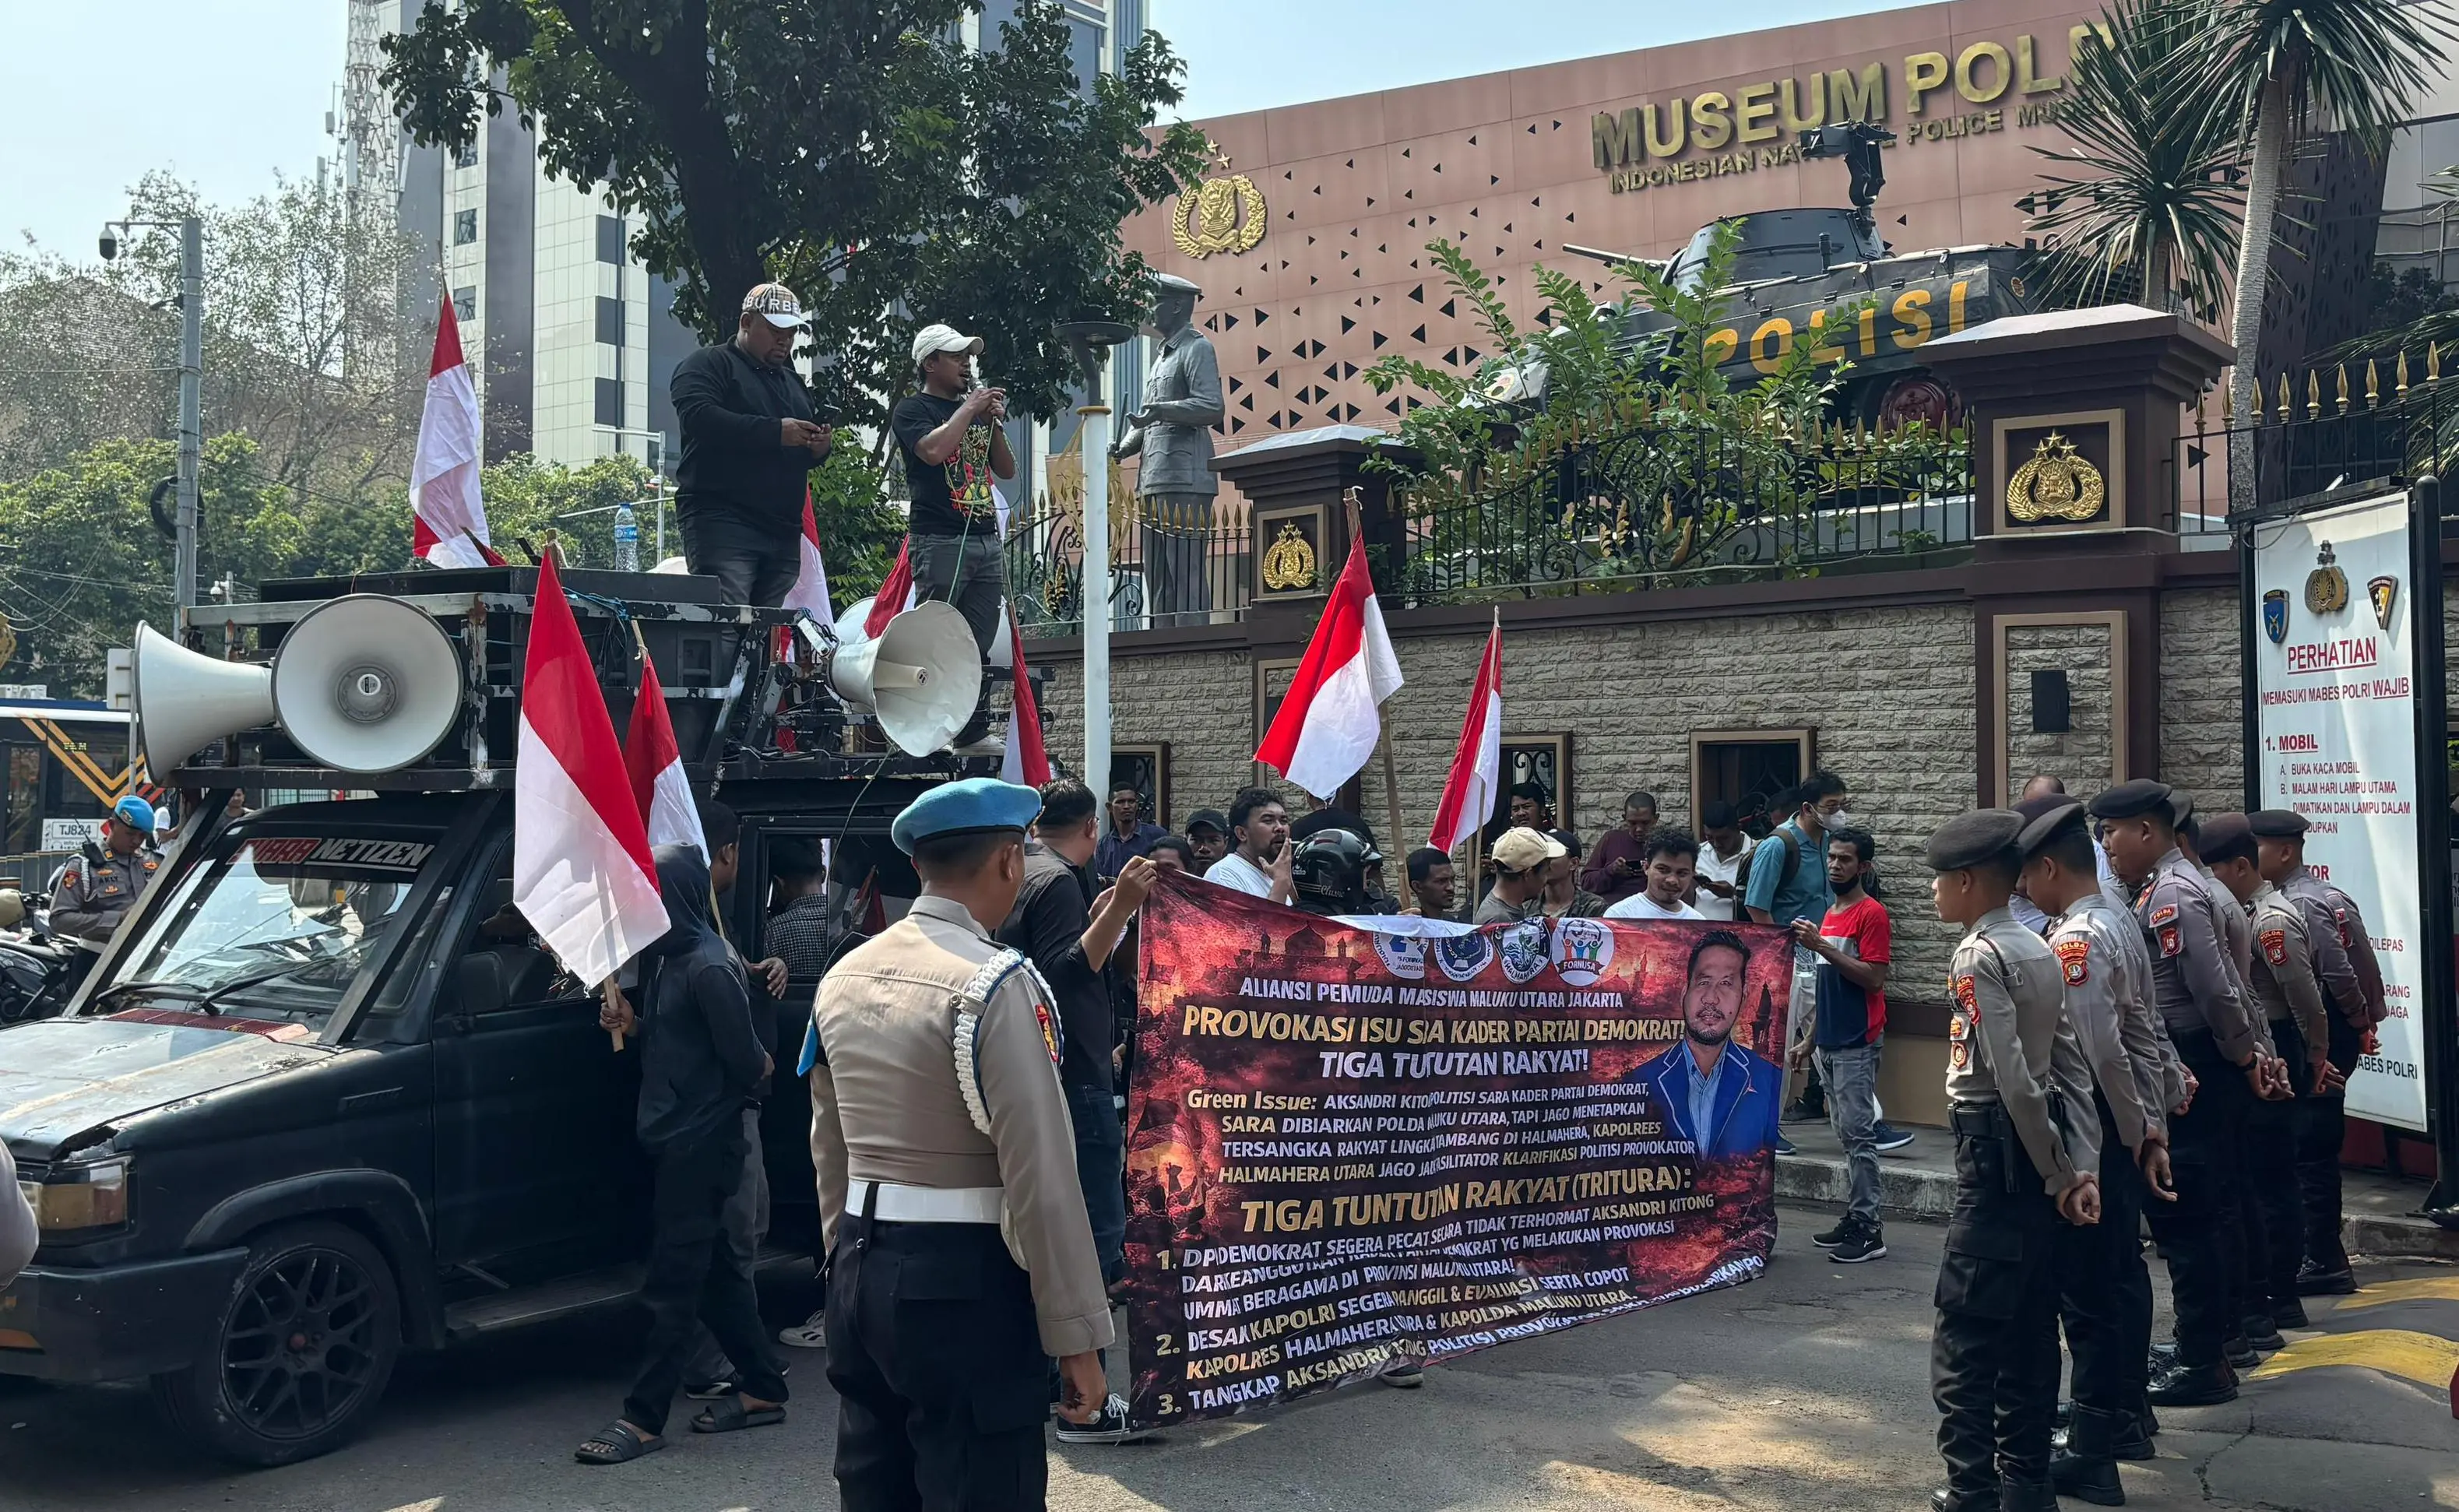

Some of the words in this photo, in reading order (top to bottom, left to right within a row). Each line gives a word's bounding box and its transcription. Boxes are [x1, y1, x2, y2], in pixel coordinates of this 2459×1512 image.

[1592, 62, 1887, 169] MUSEUM
[1609, 150, 1753, 194] INDONESIAN
[1907, 109, 2003, 144] POLICE
[1704, 280, 1968, 374] POLISI
[2288, 636, 2376, 674] PERHATIAN
[2263, 688, 2306, 705] MEMASUKI
[2309, 685, 2339, 701] MABES
[2343, 680, 2370, 698] POLRI
[2373, 677, 2409, 699] WAJIB
[2265, 737, 2275, 751] 1.
[2279, 734, 2318, 754] MOBIL
[2292, 763, 2311, 775] BUKA
[2313, 762, 2334, 775] KACA
[2336, 761, 2360, 774] MOBIL
[2281, 783, 2288, 795] B.
[2292, 782, 2318, 794] MALAM
[2320, 782, 2338, 794] HARI
[2339, 782, 2366, 794] LAMPU
[2369, 781, 2397, 793] UTAMA
[2292, 802, 2332, 814] DIMATIKAN
[2334, 802, 2350, 814] DAN
[2352, 802, 2379, 814] LAMPU
[2381, 802, 2411, 814] DALAM
[59, 825, 91, 835] TJ824
[2306, 821, 2338, 834] DUPKAN
[311, 839, 436, 866] NETIZEN
[2057, 943, 2086, 952] POLDA
[1239, 977, 1311, 1001] ALIANSI
[1317, 983, 1393, 1006] PEMUDA
[1469, 990, 1517, 1008] MALUKU
[1519, 991, 1565, 1008] UTARA
[1567, 992, 1624, 1009] JAKARTA
[1183, 1005, 1356, 1043] PROVOKASI
[1360, 1017, 1402, 1045] ISU
[1451, 1020, 1510, 1044] KADER
[1514, 1020, 1580, 1043] PARTAI
[1584, 1019, 1685, 1042] DEMOKRAT!
[1320, 1052, 1384, 1078] TIGA
[1503, 1049, 1588, 1074] RAKYAT!
[2355, 1054, 2383, 1074] ABES
[2387, 1060, 2418, 1080] POLRI
[1188, 1089, 1247, 1109] Green
[1254, 1091, 1317, 1111] Issue:
[1324, 1094, 1396, 1110] AKSANDRI
[1478, 1092, 1509, 1104] SARA
[1512, 1090, 1549, 1104] KADER
[1551, 1088, 1585, 1101] PARTAI
[1587, 1083, 1649, 1099] DEMOKRAT,
[1222, 1115, 1276, 1134] SARA
[1282, 1116, 1372, 1134] DIBIARKAN
[1377, 1116, 1425, 1132] POLDA
[1461, 1112, 1510, 1127] UTARA,
[1511, 1112, 1538, 1126] TAPI
[1543, 1107, 1570, 1123] JAGO
[1572, 1102, 1645, 1120] MENETAPKAN
[1222, 1141, 1332, 1159] TERSANGKA
[1337, 1140, 1388, 1157] RAKYAT
[1434, 1132, 1500, 1149] TAMBANG
[1503, 1132, 1518, 1145] DI
[1521, 1126, 1591, 1144] HALMAHERA,
[1593, 1121, 1662, 1138] KAPOLREES
[1219, 1166, 1330, 1183] HALMAHERA
[1334, 1163, 1375, 1181] UTARA
[1378, 1162, 1415, 1177] JAGO
[1502, 1147, 1578, 1166] KLARIFIKASI
[1580, 1144, 1620, 1159] POLITISI
[1623, 1141, 1695, 1157] PROVOKATOR
[1241, 1200, 1323, 1232] TIGA
[1332, 1183, 1461, 1227] TUNTUTAN
[1465, 1176, 1570, 1208] RAKYAT
[1157, 1250, 1177, 1270] 1.
[1218, 1241, 1322, 1266] DEMOKRAT
[1325, 1236, 1383, 1257] SEGERA
[1387, 1232, 1430, 1250] PECAT
[1466, 1215, 1506, 1236] TIDAK
[1510, 1208, 1590, 1230] TERHORMAT
[1592, 1201, 1666, 1221] AKSANDRI
[1669, 1194, 1714, 1214] KITONG
[1501, 1236, 1519, 1252] YG
[1522, 1225, 1601, 1249] MELAKUKAN
[1603, 1220, 1675, 1242] PROVOKASI
[1243, 1275, 1339, 1312] BERAGAMA
[1342, 1271, 1359, 1289] DI
[1363, 1264, 1417, 1284] PROVINSI
[1156, 1334, 1180, 1356] 2.
[1250, 1303, 1336, 1341] KAPOLRI
[1337, 1291, 1395, 1318] SEGERA
[1451, 1285, 1461, 1302] &
[1465, 1277, 1539, 1301] EVALUASI
[1539, 1274, 1584, 1290] SERTA
[1584, 1267, 1630, 1288] COPOT
[1186, 1344, 1280, 1380] KAPOLRES
[1285, 1315, 1399, 1359] HALMAHERA
[1425, 1314, 1437, 1330] &
[1440, 1303, 1518, 1328] KAPOLDA
[1517, 1293, 1582, 1314] MALUKU
[1581, 1289, 1638, 1308] UTARA.
[1158, 1394, 1182, 1415] 3.
[1188, 1375, 1280, 1410] TANGKAP
[1286, 1345, 1391, 1389] AKSANDRI
[1427, 1331, 1497, 1355] POLITISI
